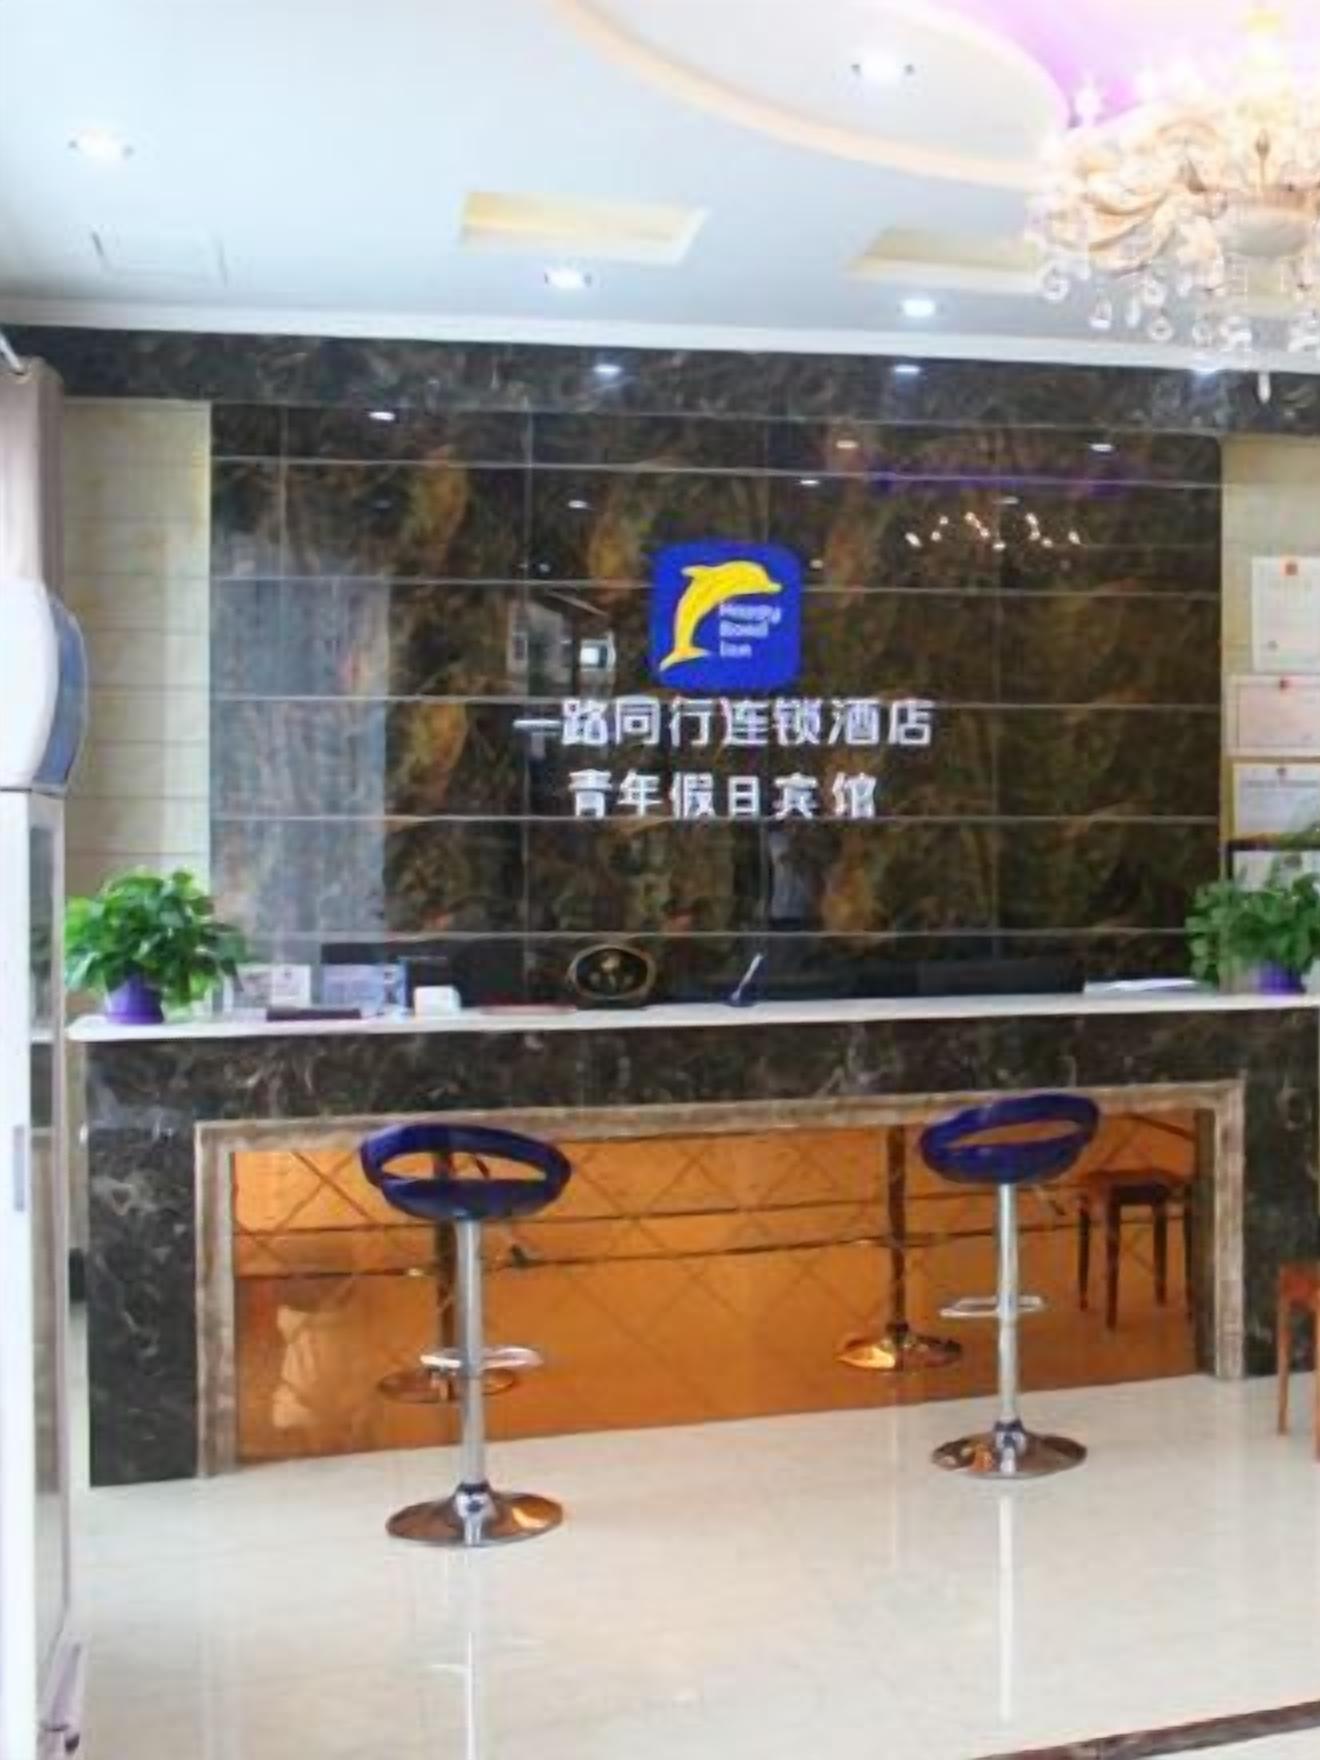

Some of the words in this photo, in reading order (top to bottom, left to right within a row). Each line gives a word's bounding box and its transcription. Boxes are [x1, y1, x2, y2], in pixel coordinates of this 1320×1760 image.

[513, 694, 936, 746] 一路同行连锁酒店
[568, 768, 877, 819] 青年假日宾馆
